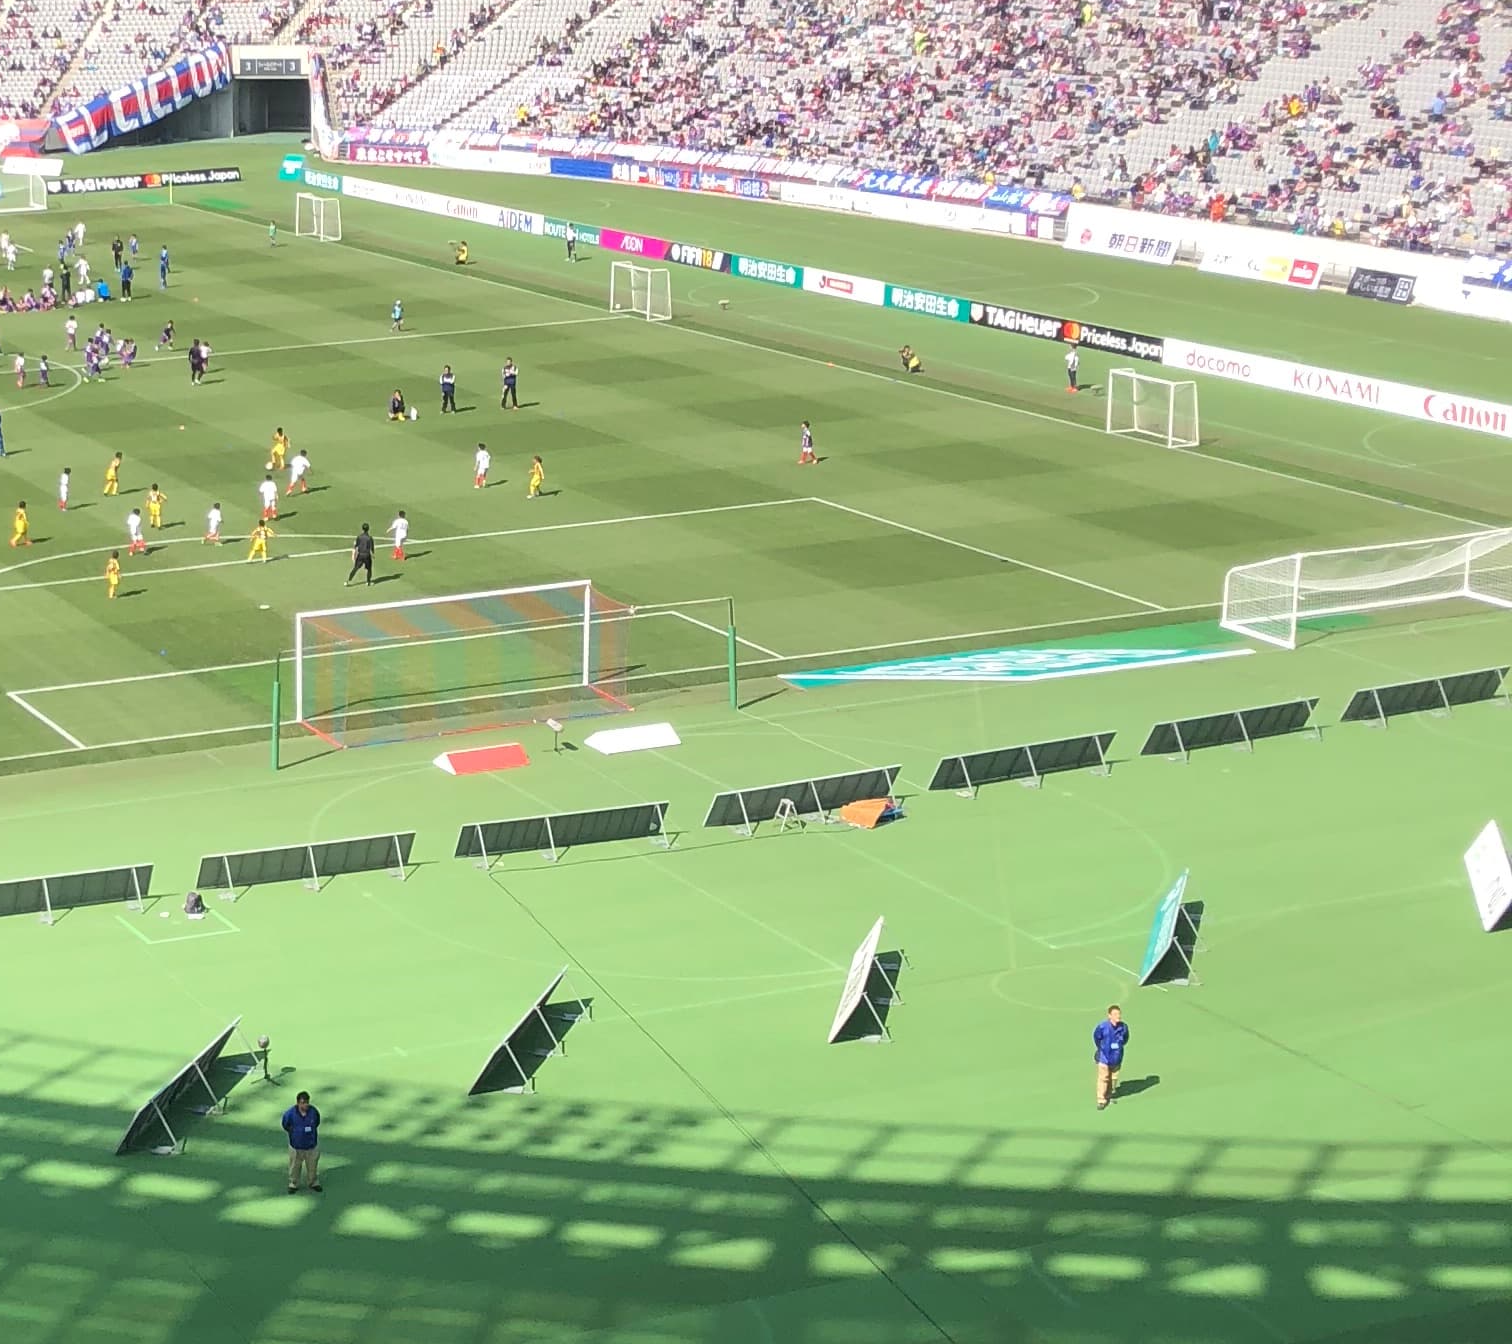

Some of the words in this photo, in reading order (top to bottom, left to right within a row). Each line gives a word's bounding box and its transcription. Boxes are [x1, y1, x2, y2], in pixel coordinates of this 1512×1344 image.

[207, 168, 241, 182] Japan
[1108, 232, 1172, 258] 朝日新聞
[738, 256, 797, 285] 明治安田生命
[891, 283, 960, 319] 明治安田生命
[1080, 326, 1127, 352] Priceless
[1128, 336, 1163, 359] Japan
[1186, 350, 1251, 378] docomo
[1293, 368, 1381, 405] KONAMI
[1423, 394, 1507, 433] Canon
